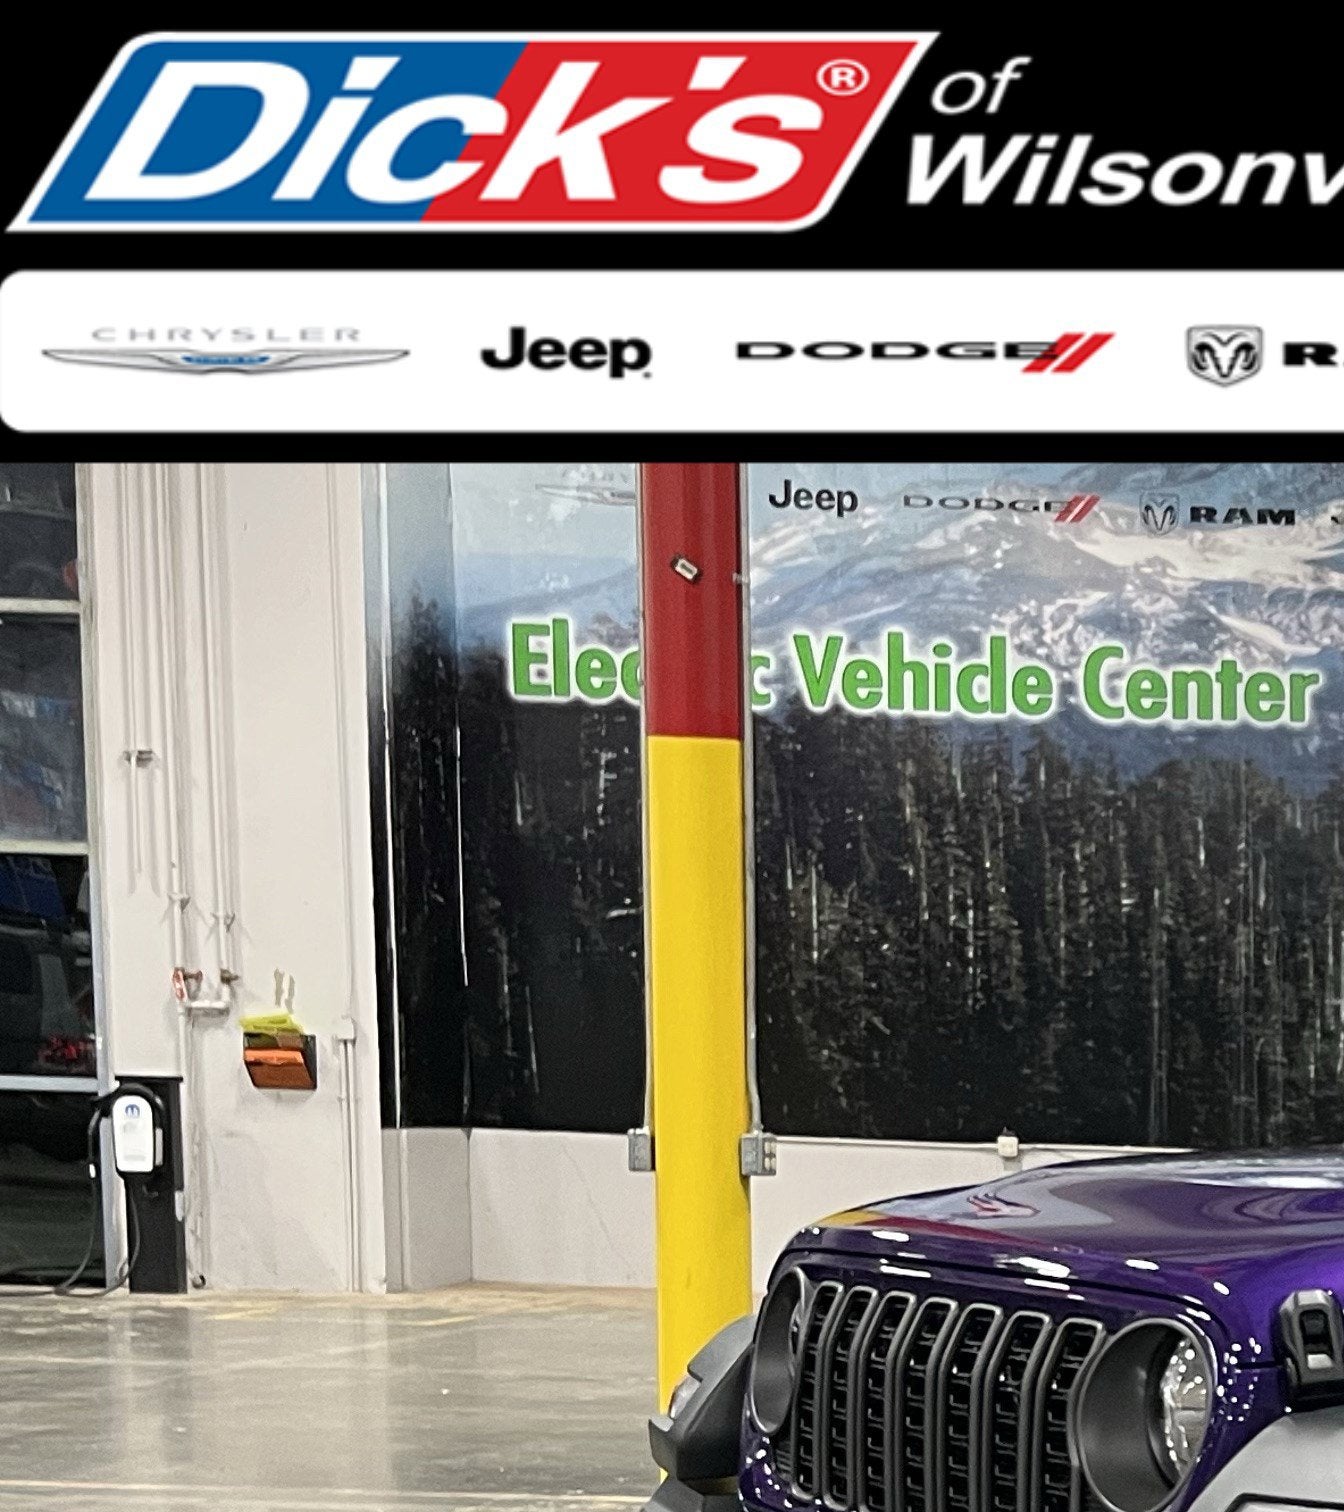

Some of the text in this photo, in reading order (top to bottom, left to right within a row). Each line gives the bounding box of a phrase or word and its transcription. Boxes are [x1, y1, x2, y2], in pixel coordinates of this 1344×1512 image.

[767, 479, 859, 517] Jeep
[902, 494, 1068, 513] DODGE
[1188, 505, 1296, 527] RAM
[792, 630, 1054, 716] Vehicle
[1082, 644, 1321, 723] Center
